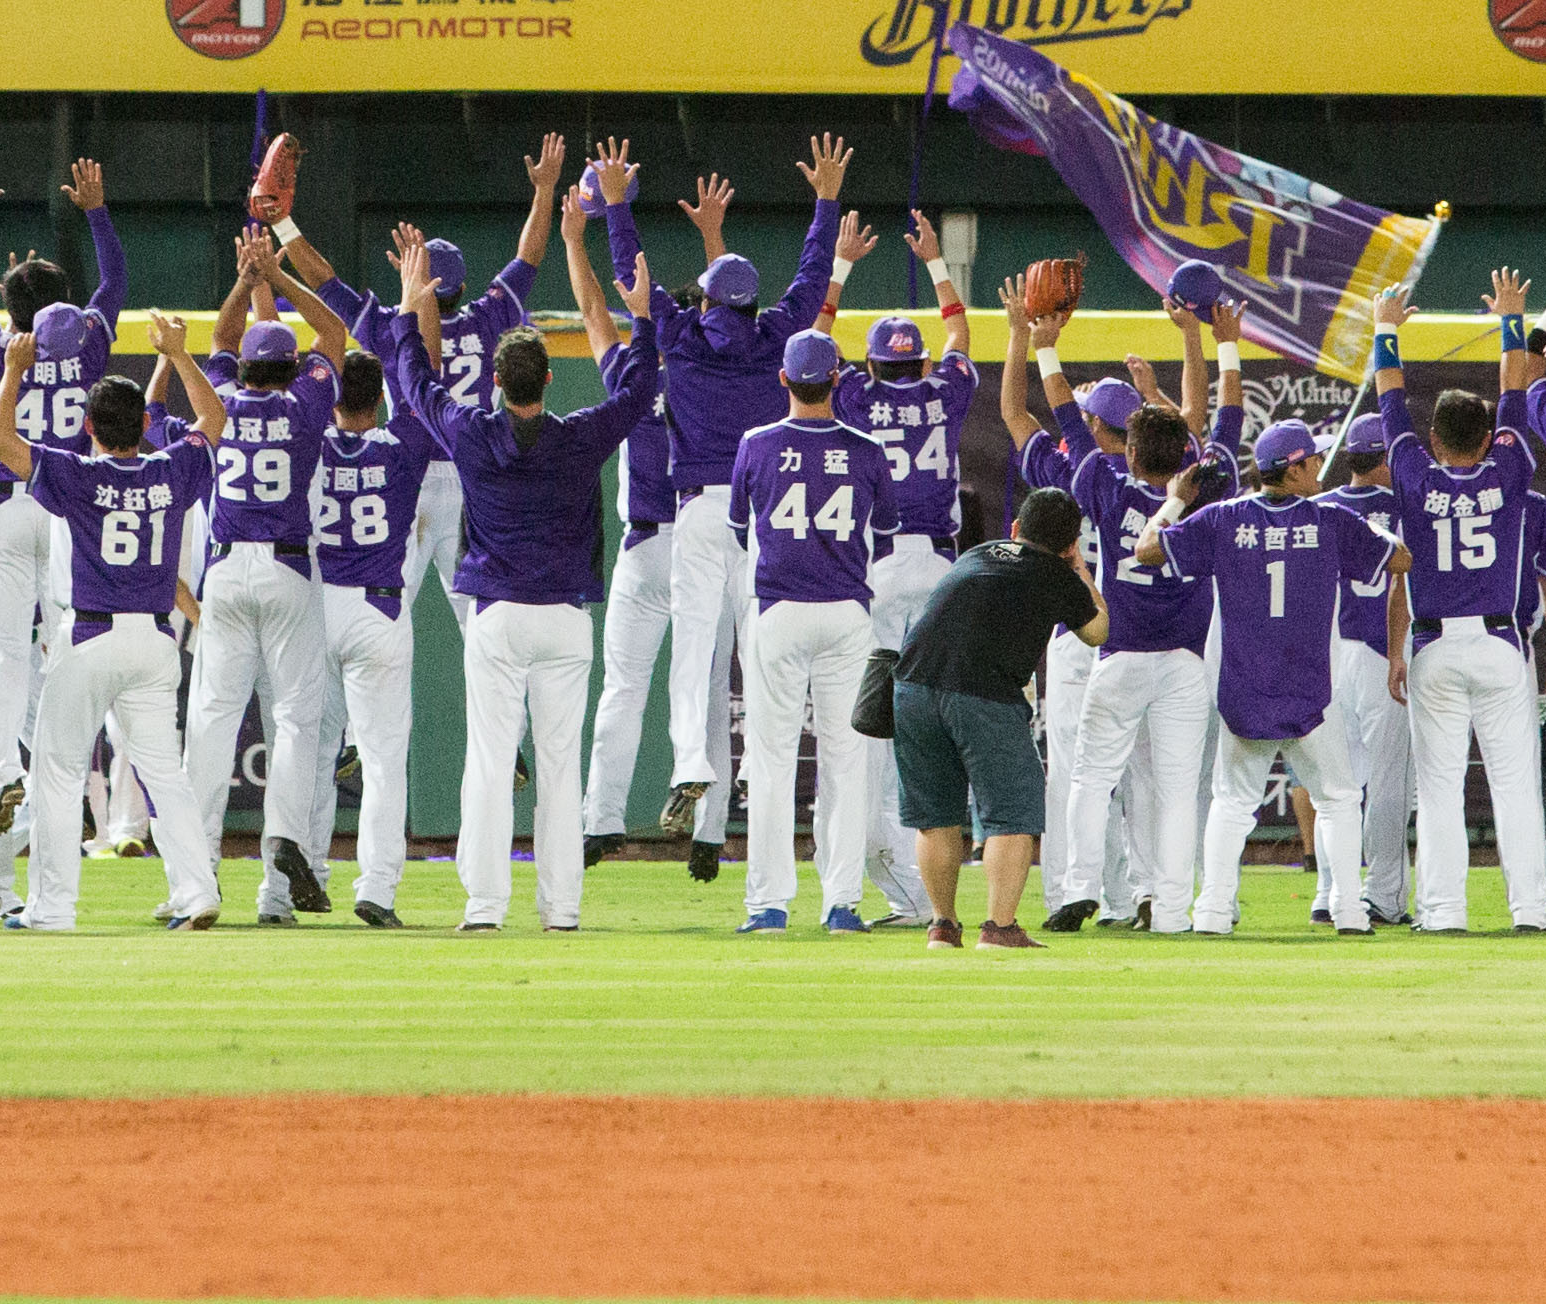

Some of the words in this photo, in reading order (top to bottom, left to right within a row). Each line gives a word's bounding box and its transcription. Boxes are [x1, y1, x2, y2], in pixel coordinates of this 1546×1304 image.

[15, 387, 88, 440] 46
[216, 447, 292, 503] 29
[778, 447, 850, 475] 力猛
[870, 425, 950, 482] 54
[100, 510, 166, 566] 61
[320, 494, 390, 546] 28
[769, 482, 856, 542] 44
[1432, 514, 1497, 572] 15
[1265, 560, 1286, 618] 1
